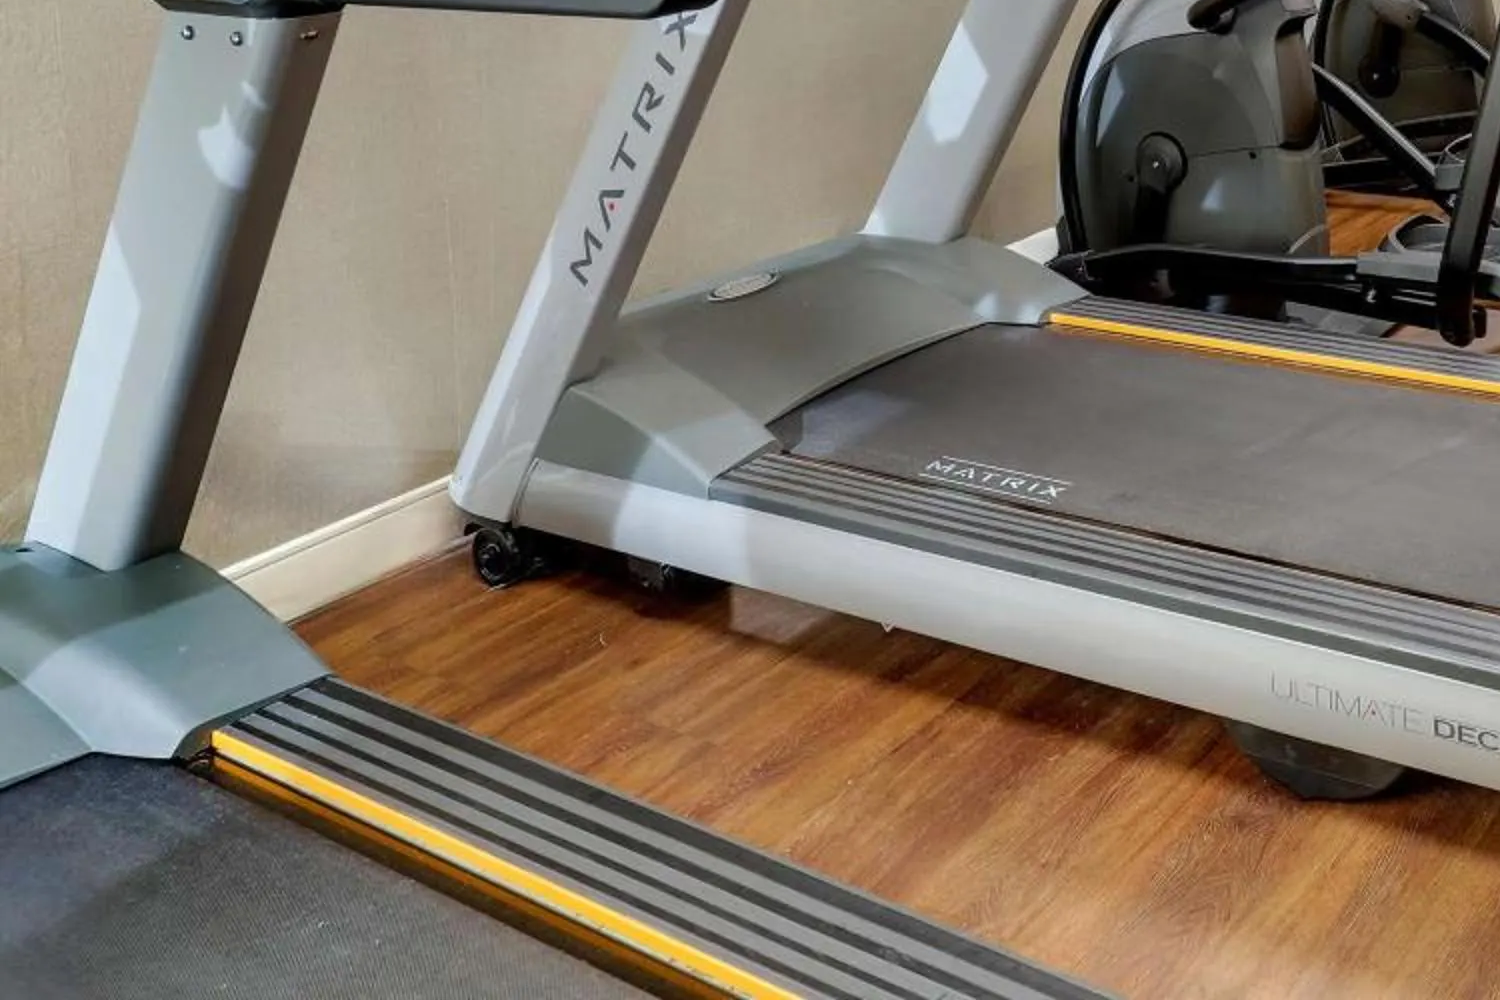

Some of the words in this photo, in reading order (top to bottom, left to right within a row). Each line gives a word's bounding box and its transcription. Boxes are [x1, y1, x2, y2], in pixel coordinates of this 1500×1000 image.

[568, 10, 700, 287] MATRIX
[925, 459, 1068, 499] MATRIX
[1269, 669, 1426, 736] ULTIMATE
